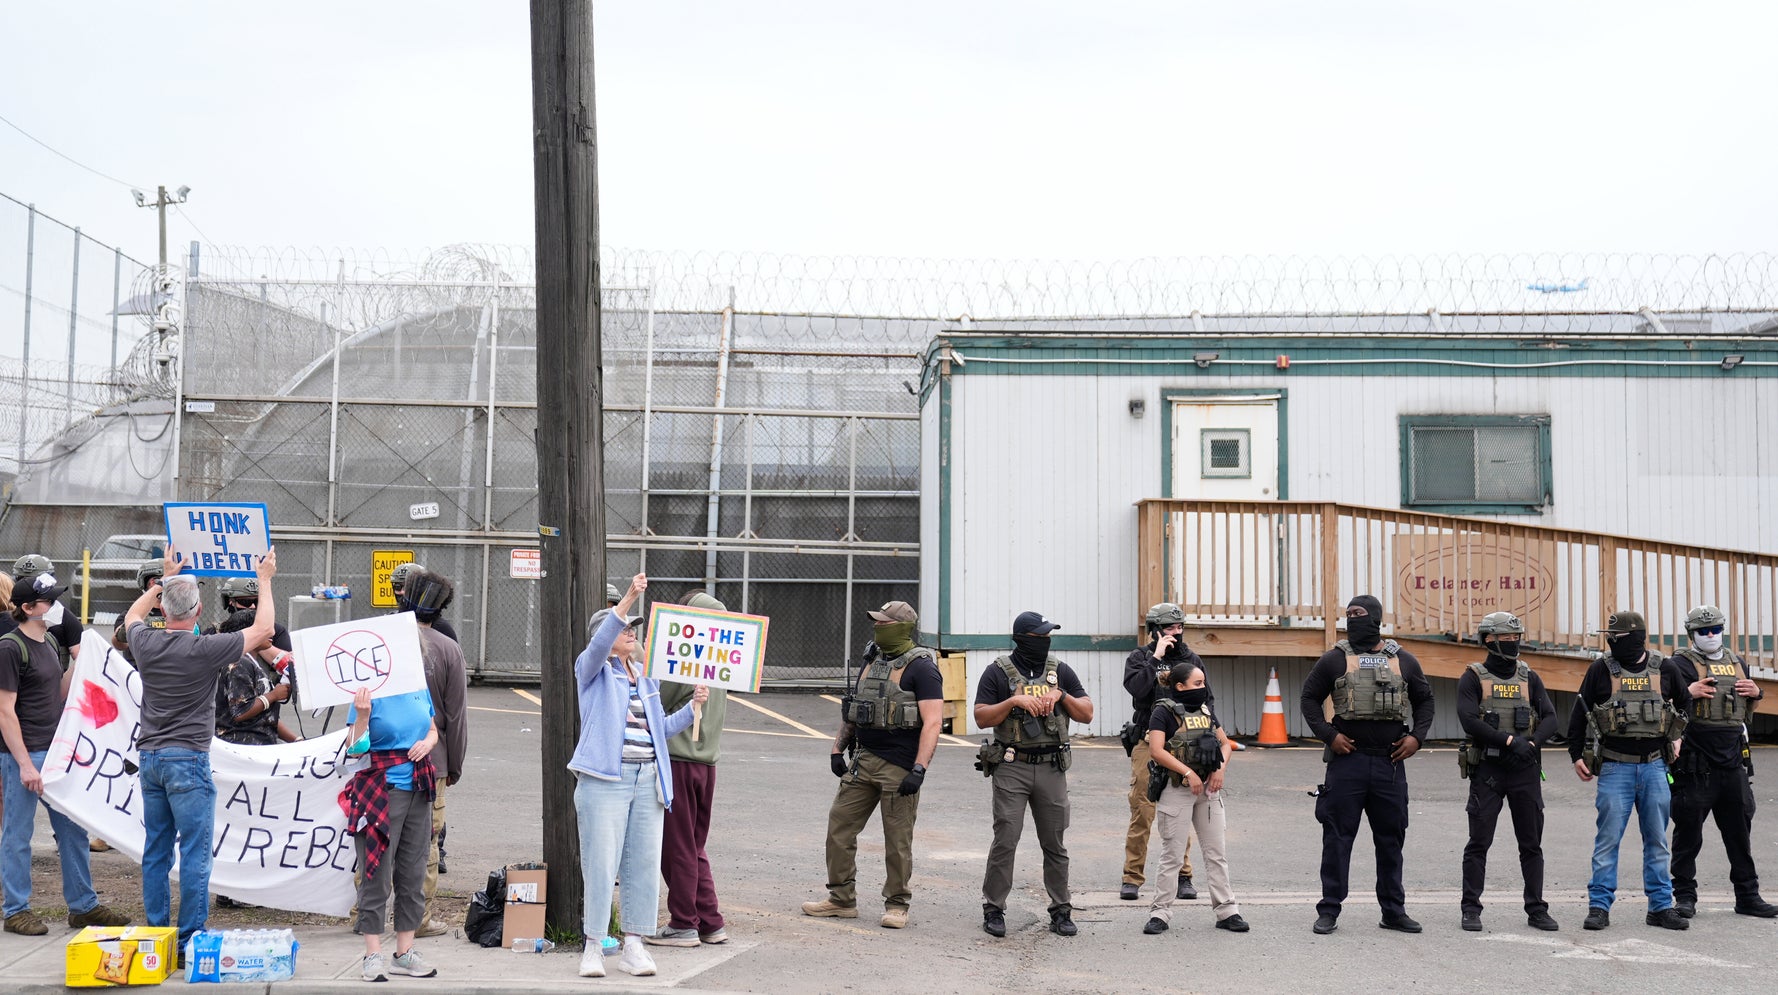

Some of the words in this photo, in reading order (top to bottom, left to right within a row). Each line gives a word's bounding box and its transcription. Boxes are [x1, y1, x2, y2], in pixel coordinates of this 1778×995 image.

[412, 507, 430, 516] GATE
[432, 506, 437, 514] 5
[188, 511, 251, 535] HONK
[213, 534, 229, 556] 4
[1500, 576, 1536, 590] Hall
[667, 622, 745, 646] DO-THE
[666, 640, 742, 665] LOVING
[326, 644, 390, 685] ICE
[1360, 657, 1387, 666] POLICE
[667, 660, 731, 682] THING
[1709, 664, 1736, 676] ERO
[1621, 677, 1649, 685] POLICE
[1023, 684, 1050, 698] ERO
[1493, 684, 1520, 693] POLICE
[1184, 716, 1210, 730] ERO
[225, 780, 315, 823] ALL
[146, 956, 157, 966] 50
